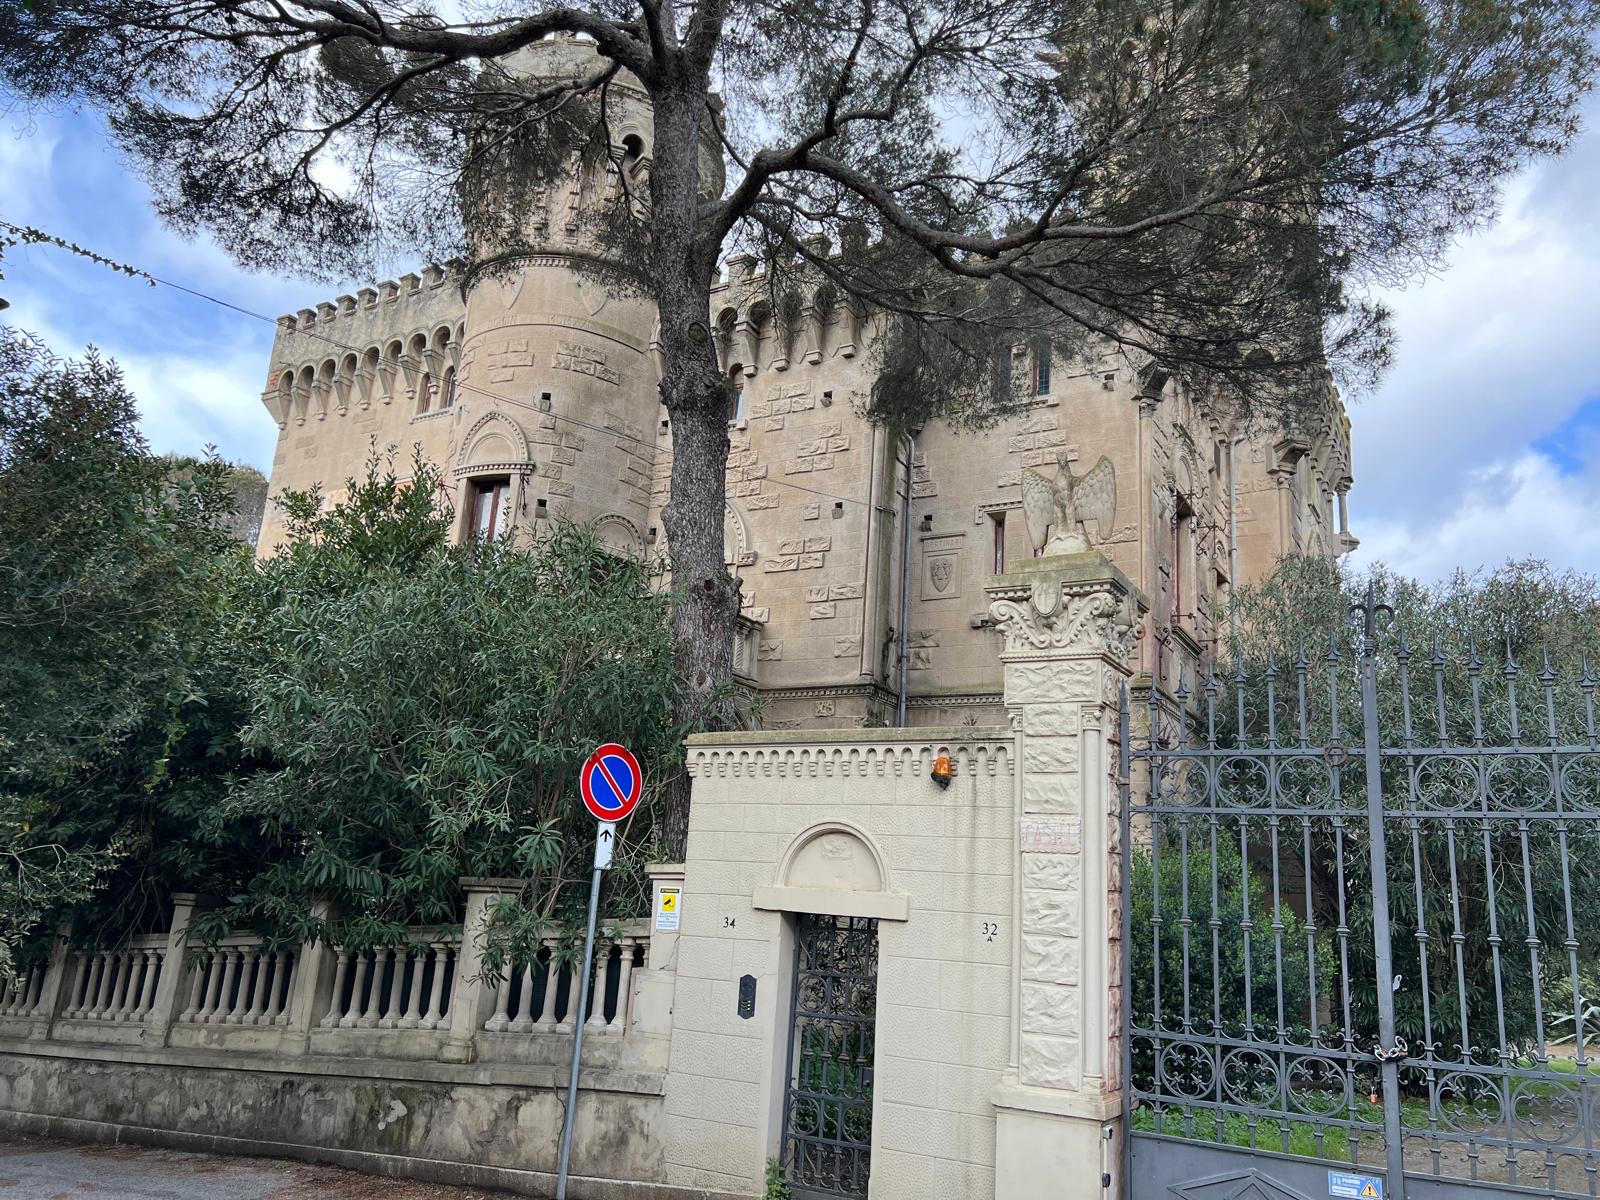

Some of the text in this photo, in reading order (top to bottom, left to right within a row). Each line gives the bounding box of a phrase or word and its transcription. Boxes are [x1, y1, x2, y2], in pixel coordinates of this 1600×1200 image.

[723, 916, 736, 929] 34
[982, 922, 997, 936] 32
[986, 935, 993, 943] A
